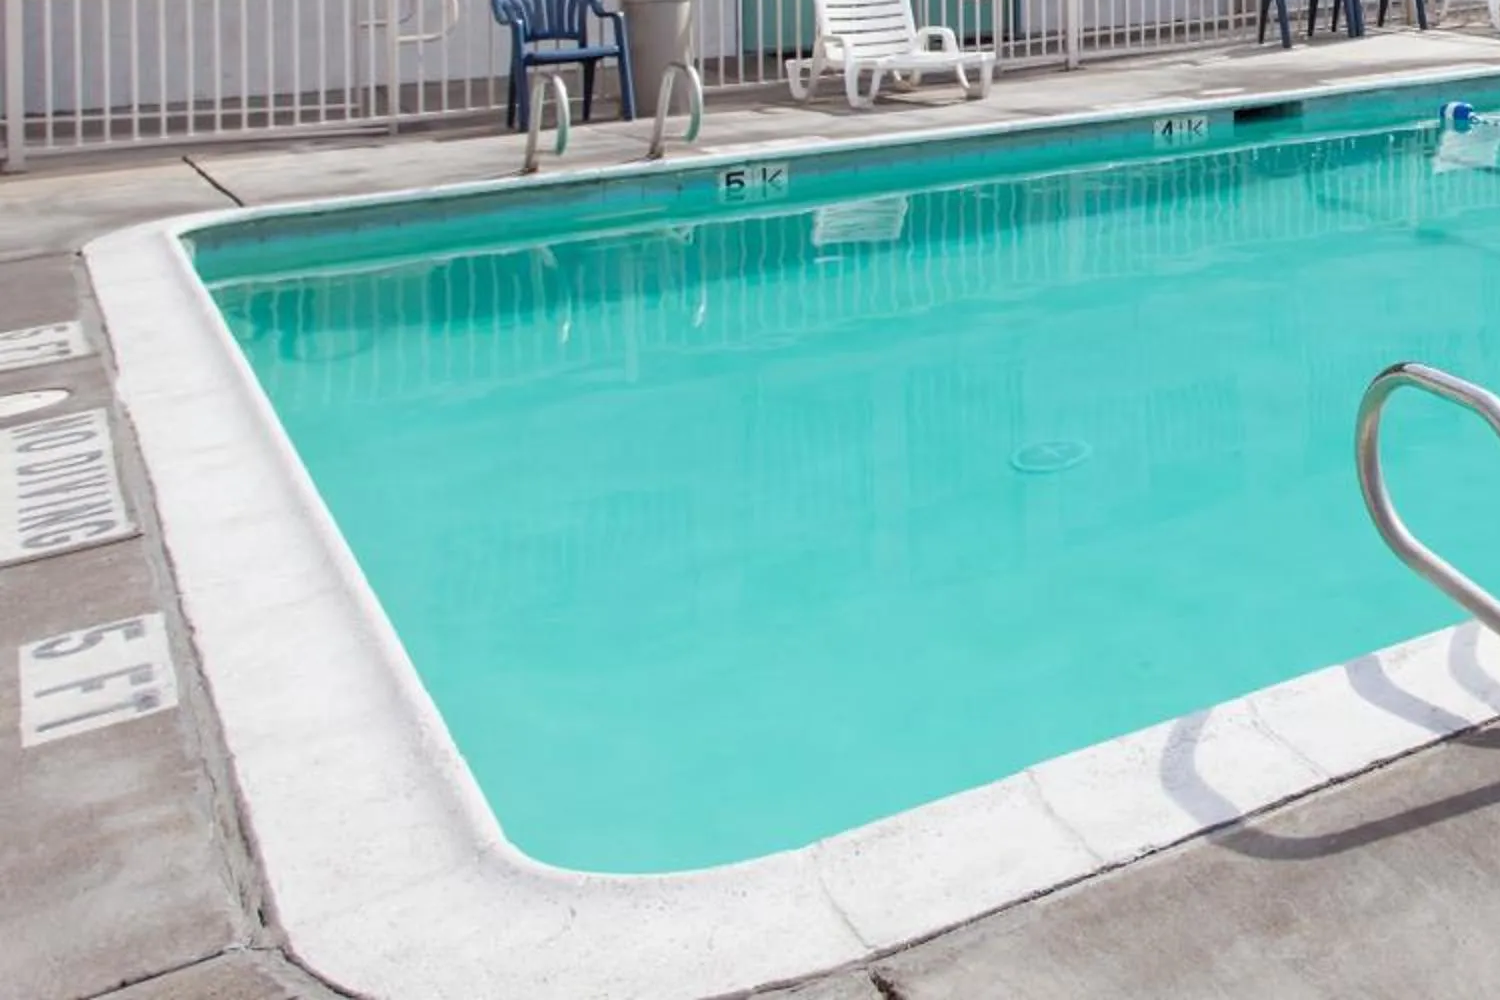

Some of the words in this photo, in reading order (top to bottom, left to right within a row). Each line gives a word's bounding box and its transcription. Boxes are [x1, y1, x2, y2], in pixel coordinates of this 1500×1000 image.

[725, 169, 745, 200] 5
[10, 413, 99, 453] NO
[16, 450, 117, 548] DIVING
[31, 619, 146, 659] 5
